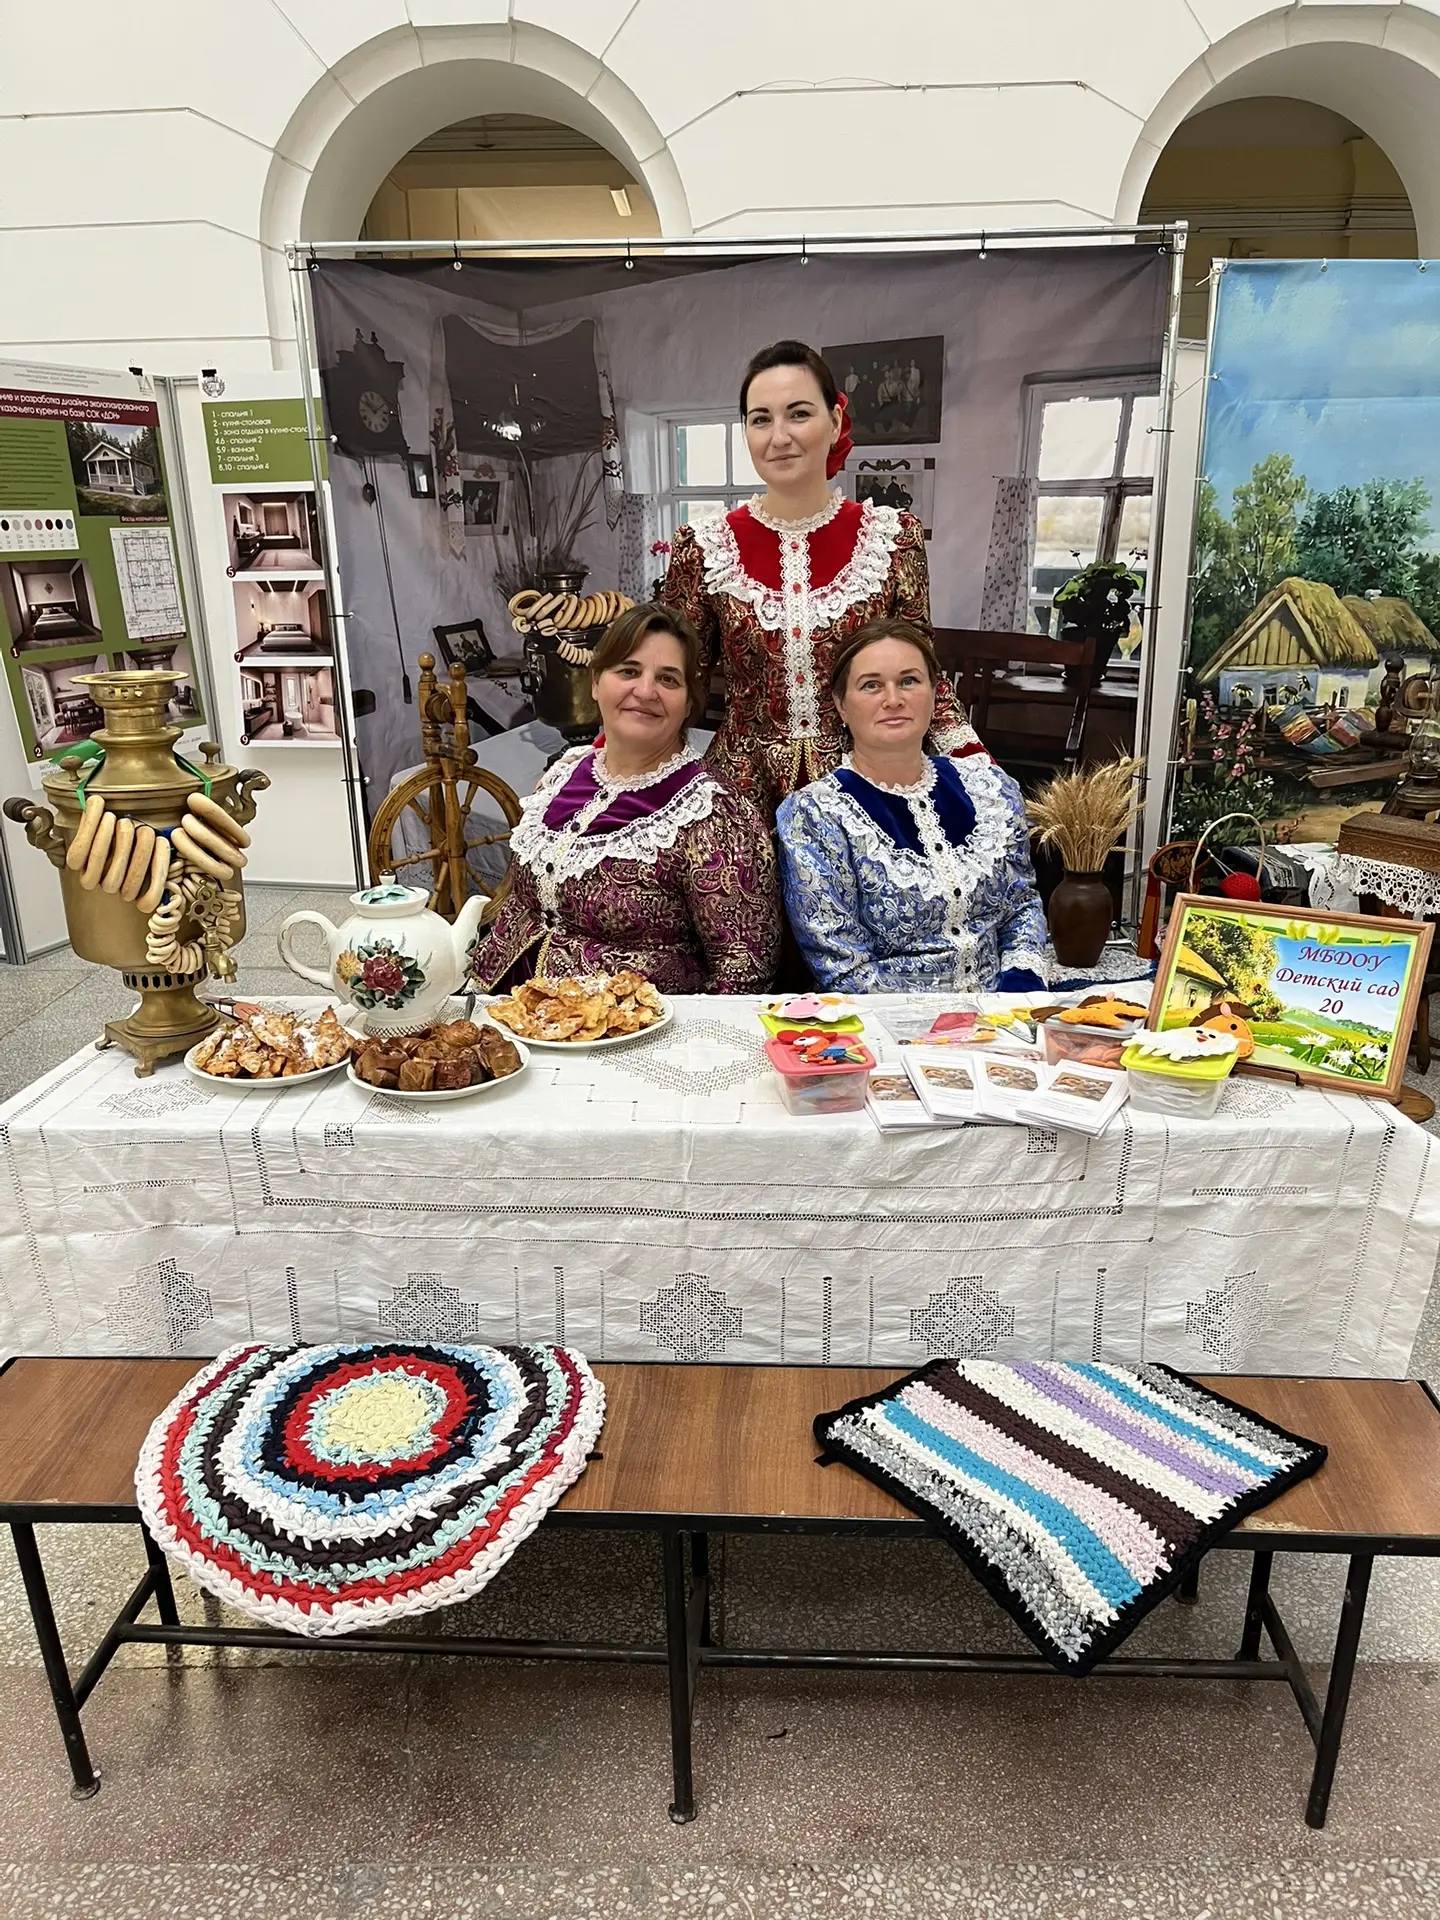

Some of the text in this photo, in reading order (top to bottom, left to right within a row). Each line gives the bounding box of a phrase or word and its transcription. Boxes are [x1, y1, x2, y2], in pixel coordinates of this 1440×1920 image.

[20, 395, 60, 405] разработка
[61, 398, 89, 407] дизайна
[35, 407, 59, 417] куреня
[60, 409, 69, 417] на
[69, 408, 85, 418] базе
[86, 410, 101, 419] СОК
[221, 410, 249, 418] спальня
[1298, 945, 1392, 972] МБДОУ
[1276, 968, 1401, 998] Детский сад
[1318, 998, 1344, 1015] 20
